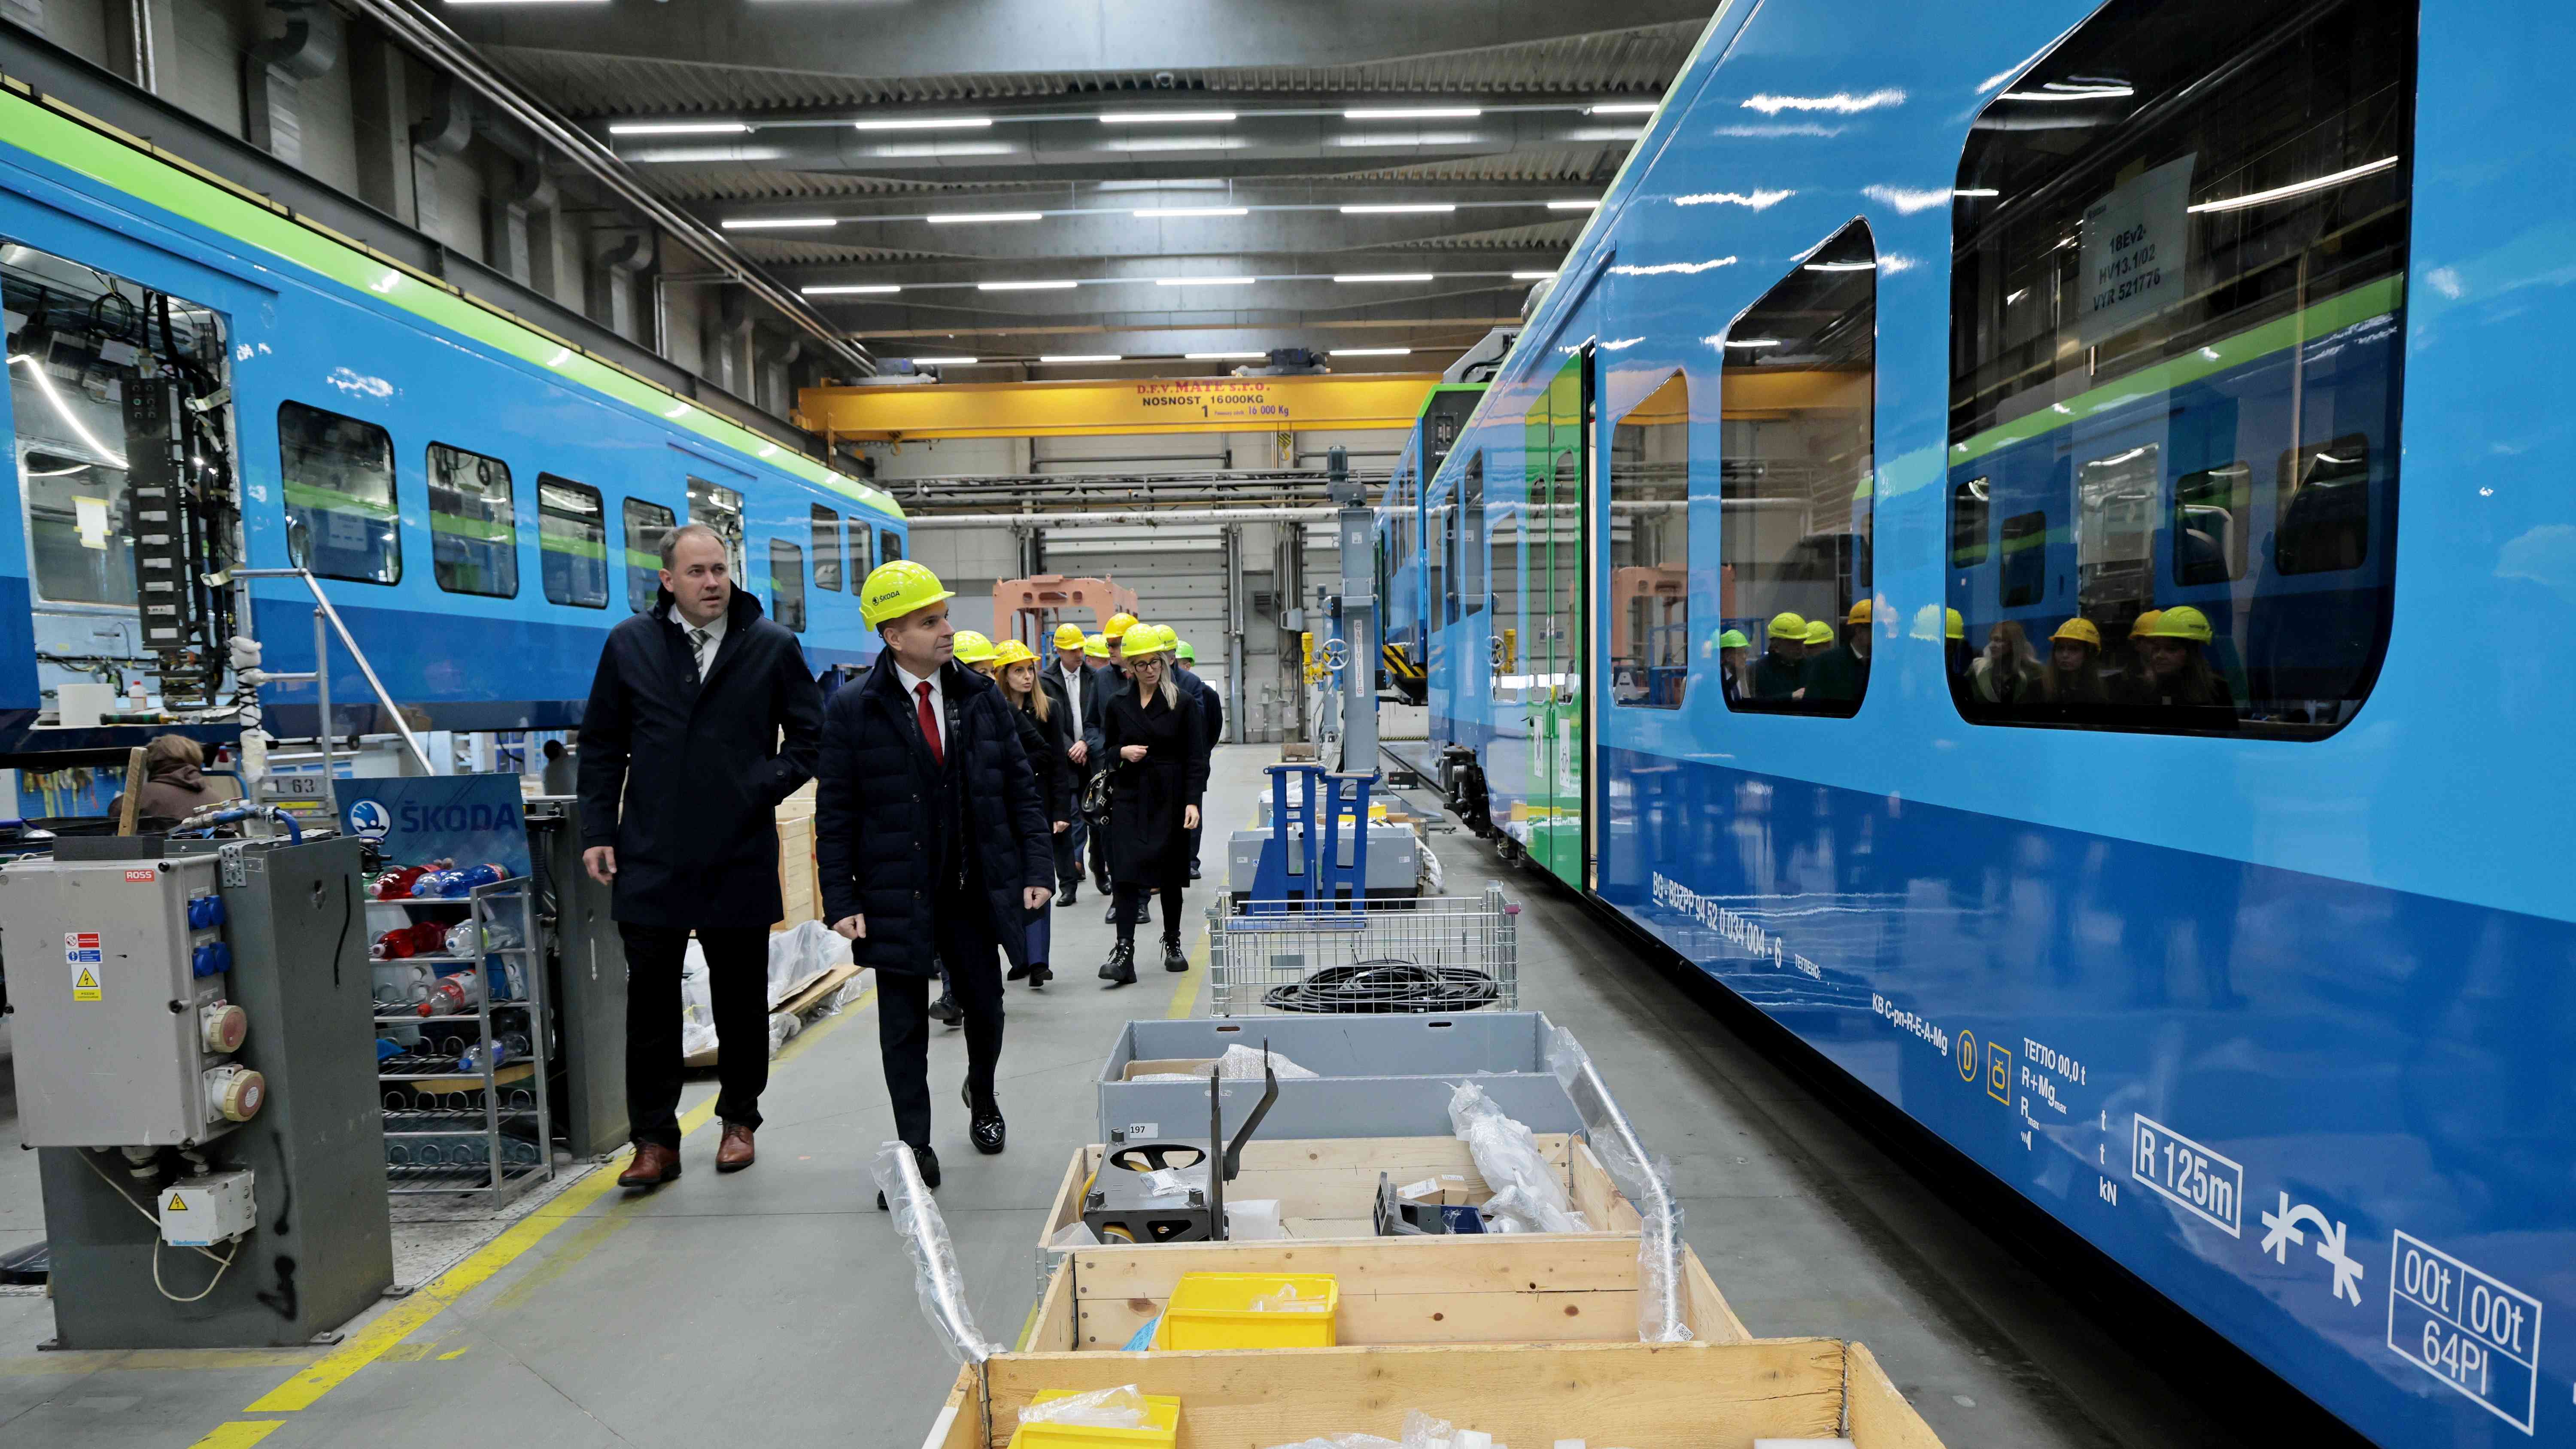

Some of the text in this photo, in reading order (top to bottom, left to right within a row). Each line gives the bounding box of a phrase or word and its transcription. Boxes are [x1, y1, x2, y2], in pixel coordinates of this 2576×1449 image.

[2099, 244, 2156, 285] HV13.1/02
[2094, 267, 2161, 311] VYR 521776
[1137, 380, 1270, 394] D.F.V. MATE s.r.o.
[1142, 395, 1264, 406] NOSNOST 16000KG
[1202, 406, 1208, 417] 1
[1249, 405, 1257, 415] 16
[1261, 405, 1275, 415] 000
[1279, 405, 1289, 416] Kg
[275, 779, 314, 793] L 63
[401, 801, 518, 833] ŠKODA
[1653, 871, 1663, 899] BG
[1669, 879, 1694, 915] BDZPP
[1696, 895, 1705, 923] 94
[1707, 901, 1717, 931] 52
[1728, 911, 1744, 946] 034
[1747, 921, 1765, 958] 004
[1774, 936, 1782, 969] 6
[1963, 1040, 1972, 1071] D
[2024, 1037, 2085, 1085] ТЕГЛО 00,0 t
[2102, 1110, 2106, 1131] t
[2100, 1144, 2105, 1164] t
[2140, 1127, 2232, 1221] R 125m
[2099, 1176, 2117, 1206] kN
[2404, 1249, 2451, 1312] 00t
[2471, 1285, 2524, 1353] 00t
